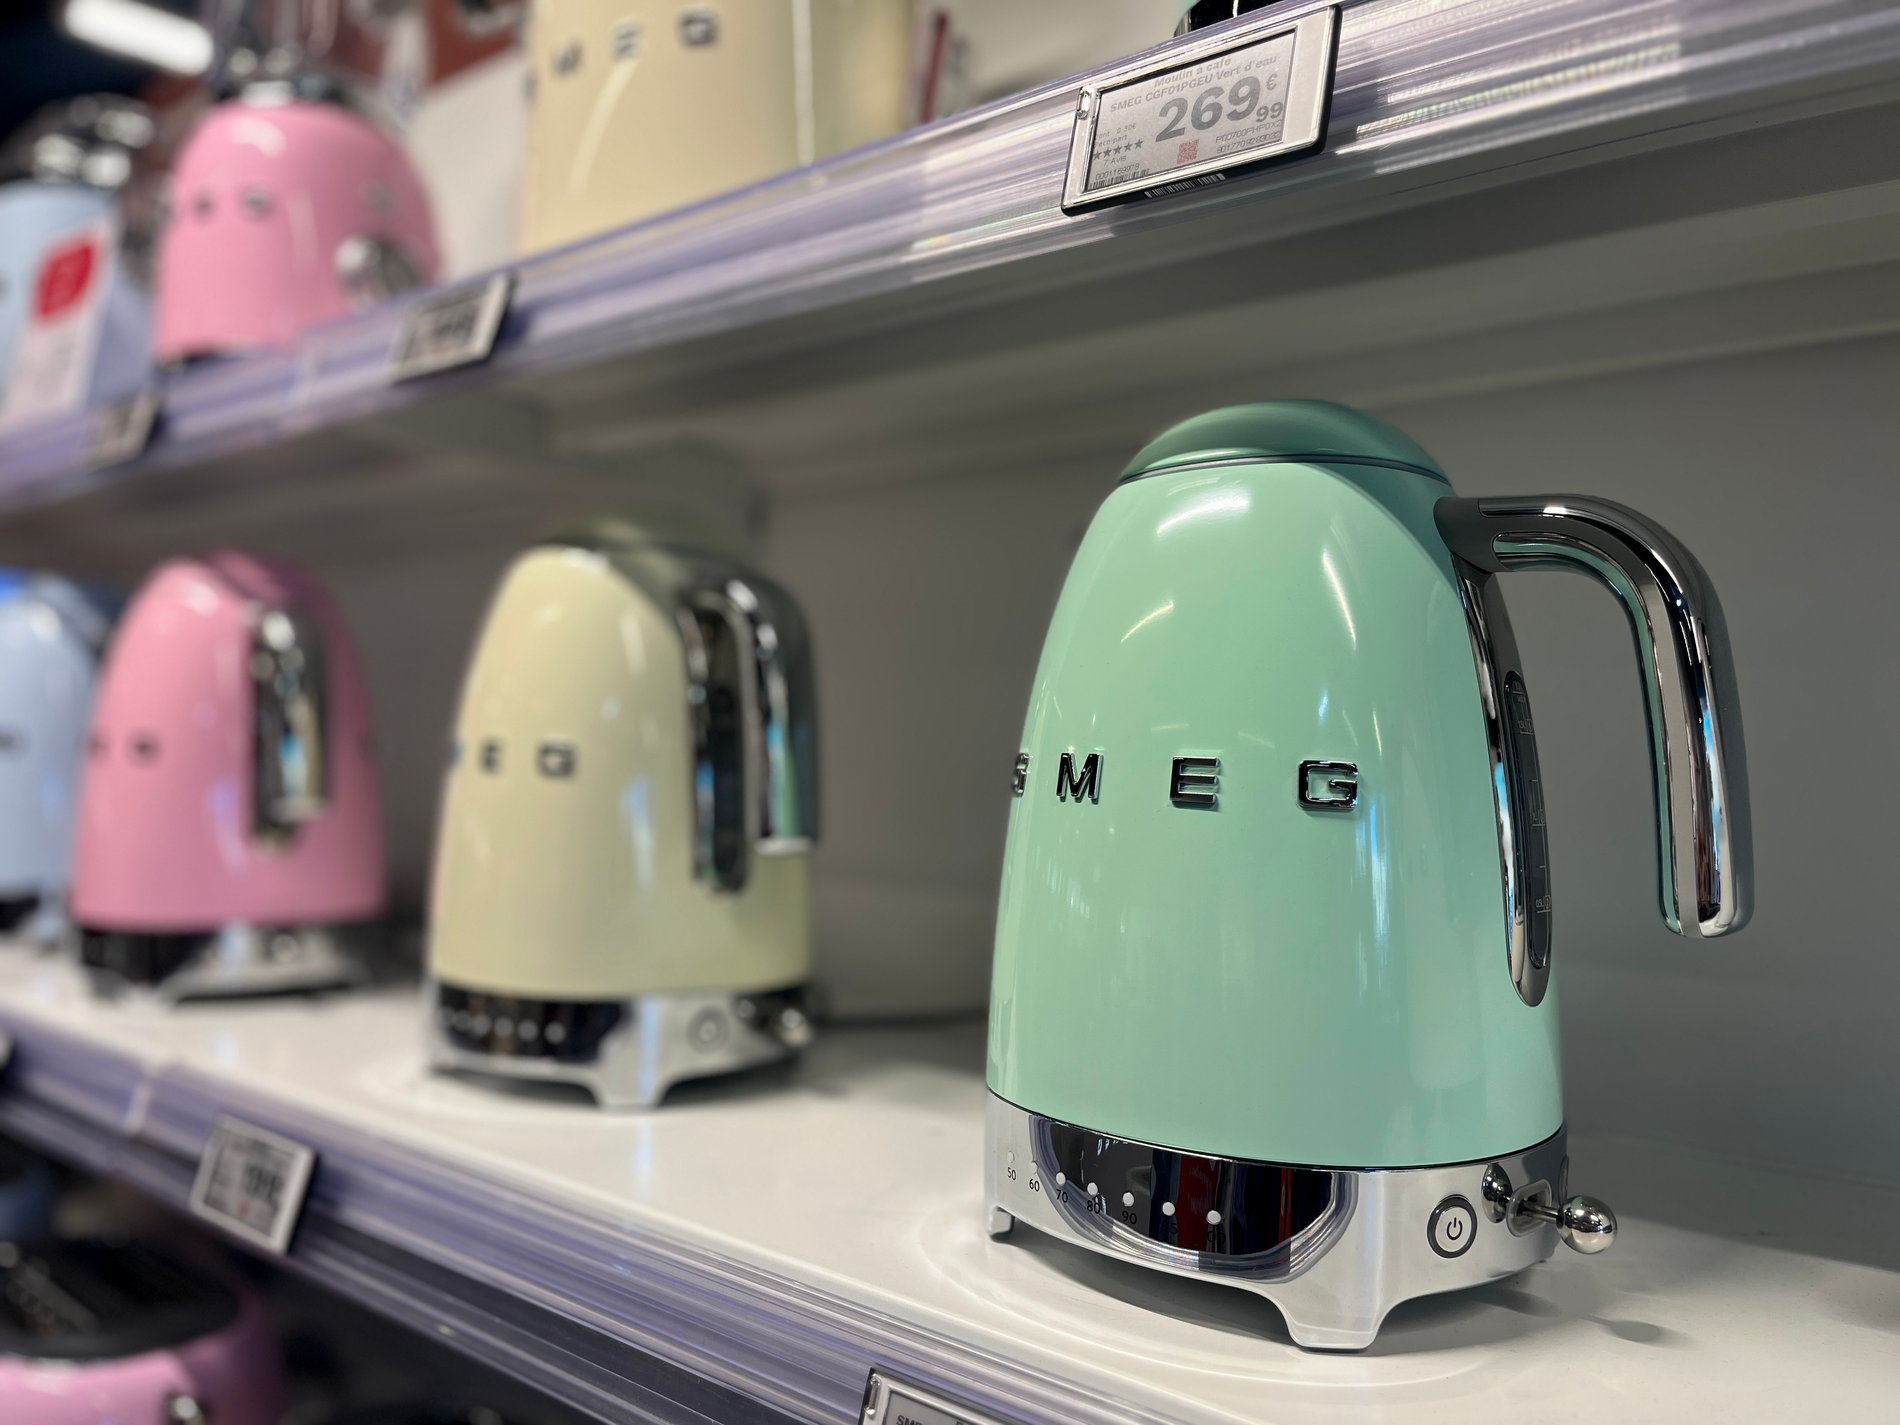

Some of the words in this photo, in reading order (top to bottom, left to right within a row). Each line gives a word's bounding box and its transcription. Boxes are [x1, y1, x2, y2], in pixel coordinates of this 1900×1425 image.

[1110, 96, 1142, 113] SMEG
[1145, 75, 1213, 102] CGF01PGEU
[1215, 66, 1241, 81] Vert
[1244, 55, 1277, 72] d'eau
[1154, 69, 1193, 88] Moulin
[1206, 58, 1232, 72] café
[1266, 73, 1278, 91] €
[1155, 76, 1261, 142] 269
[1256, 101, 1284, 123] 99
[1012, 752, 1359, 810] SMEG
[1007, 1167, 1017, 1181] 50
[1028, 1178, 1040, 1192] 60
[1055, 1189, 1068, 1204] 70
[1086, 1200, 1101, 1214] 80
[1121, 1210, 1137, 1225] 90
